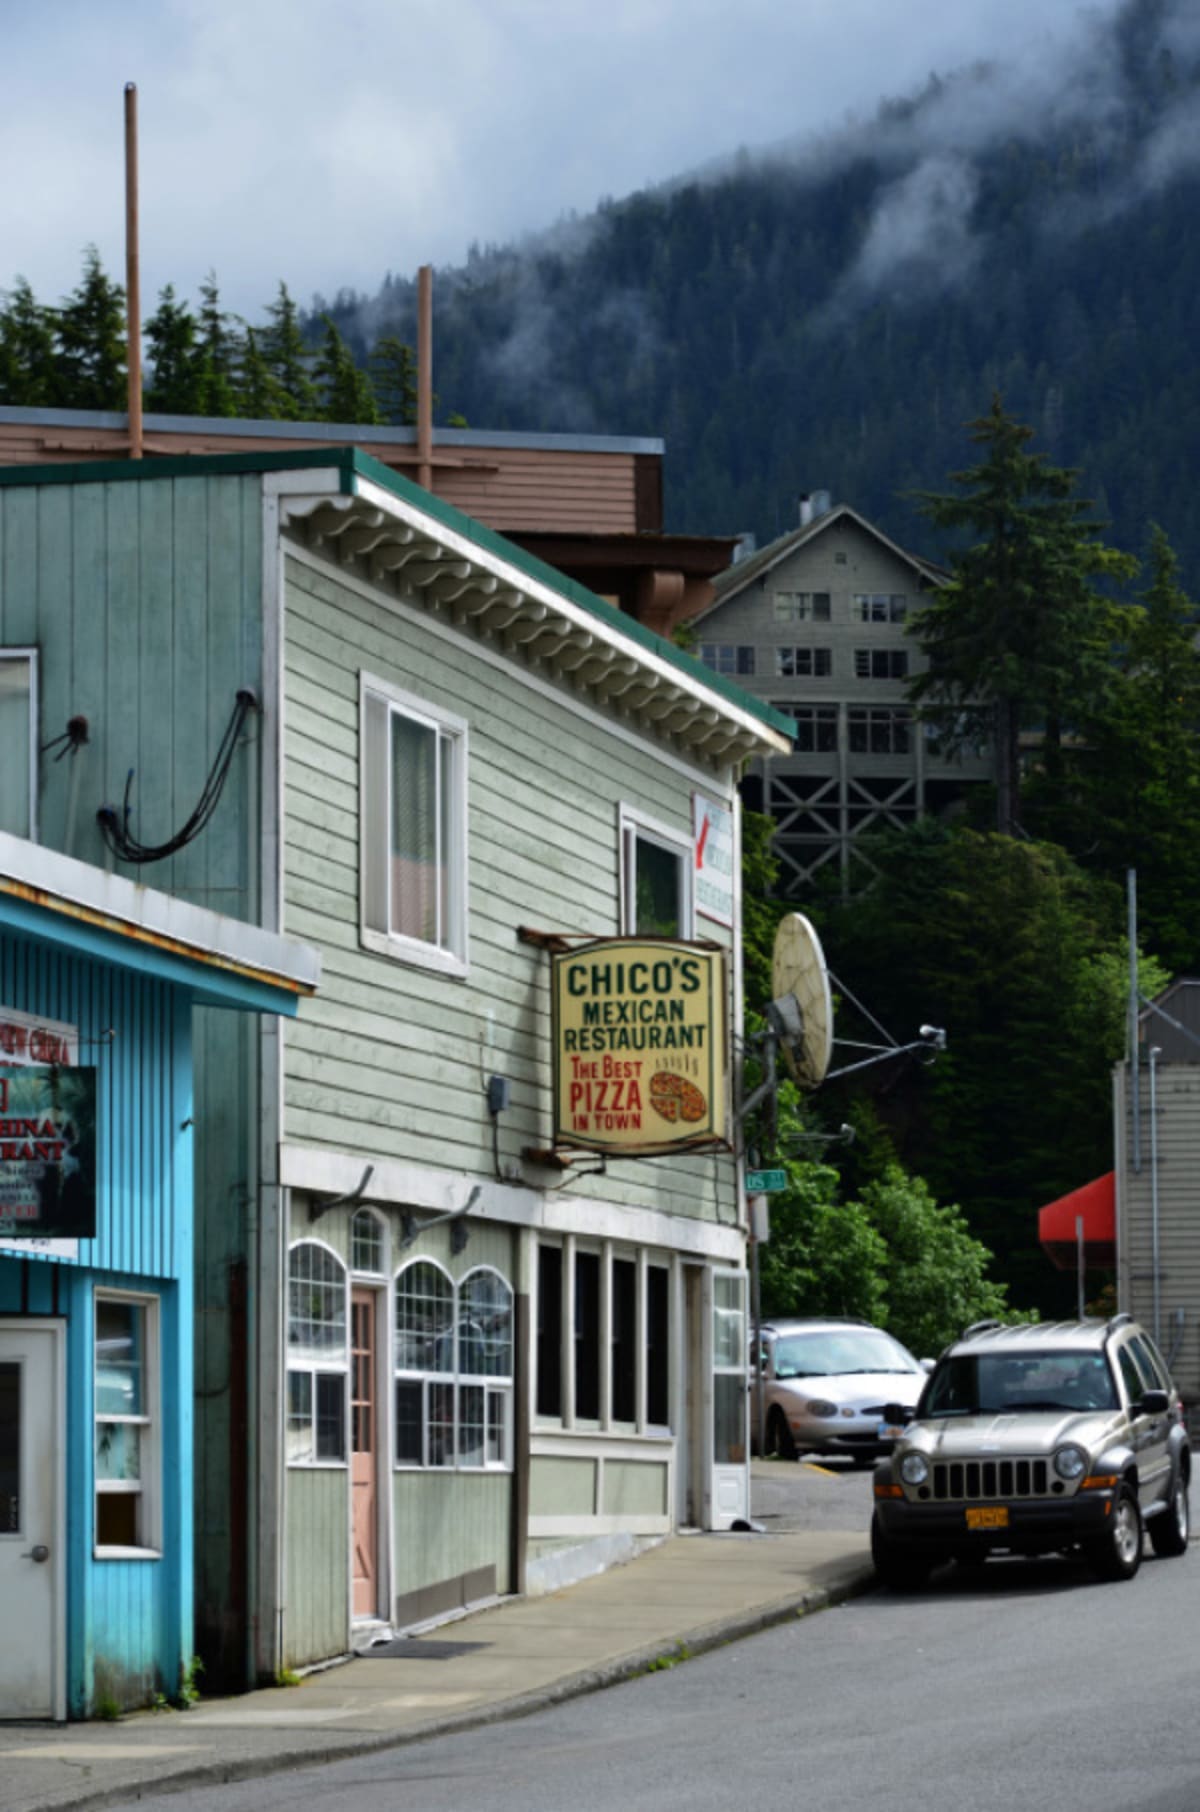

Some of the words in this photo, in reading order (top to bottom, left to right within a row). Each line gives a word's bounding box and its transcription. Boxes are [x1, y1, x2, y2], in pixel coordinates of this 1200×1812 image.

[567, 957, 700, 996] CHICO'S
[583, 1000, 685, 1025] MEXICAN
[564, 1025, 706, 1051] RESTAURANT
[570, 1080, 642, 1112] PIZZA
[573, 1114, 589, 1131] IN
[595, 1113, 641, 1131] TOWN
